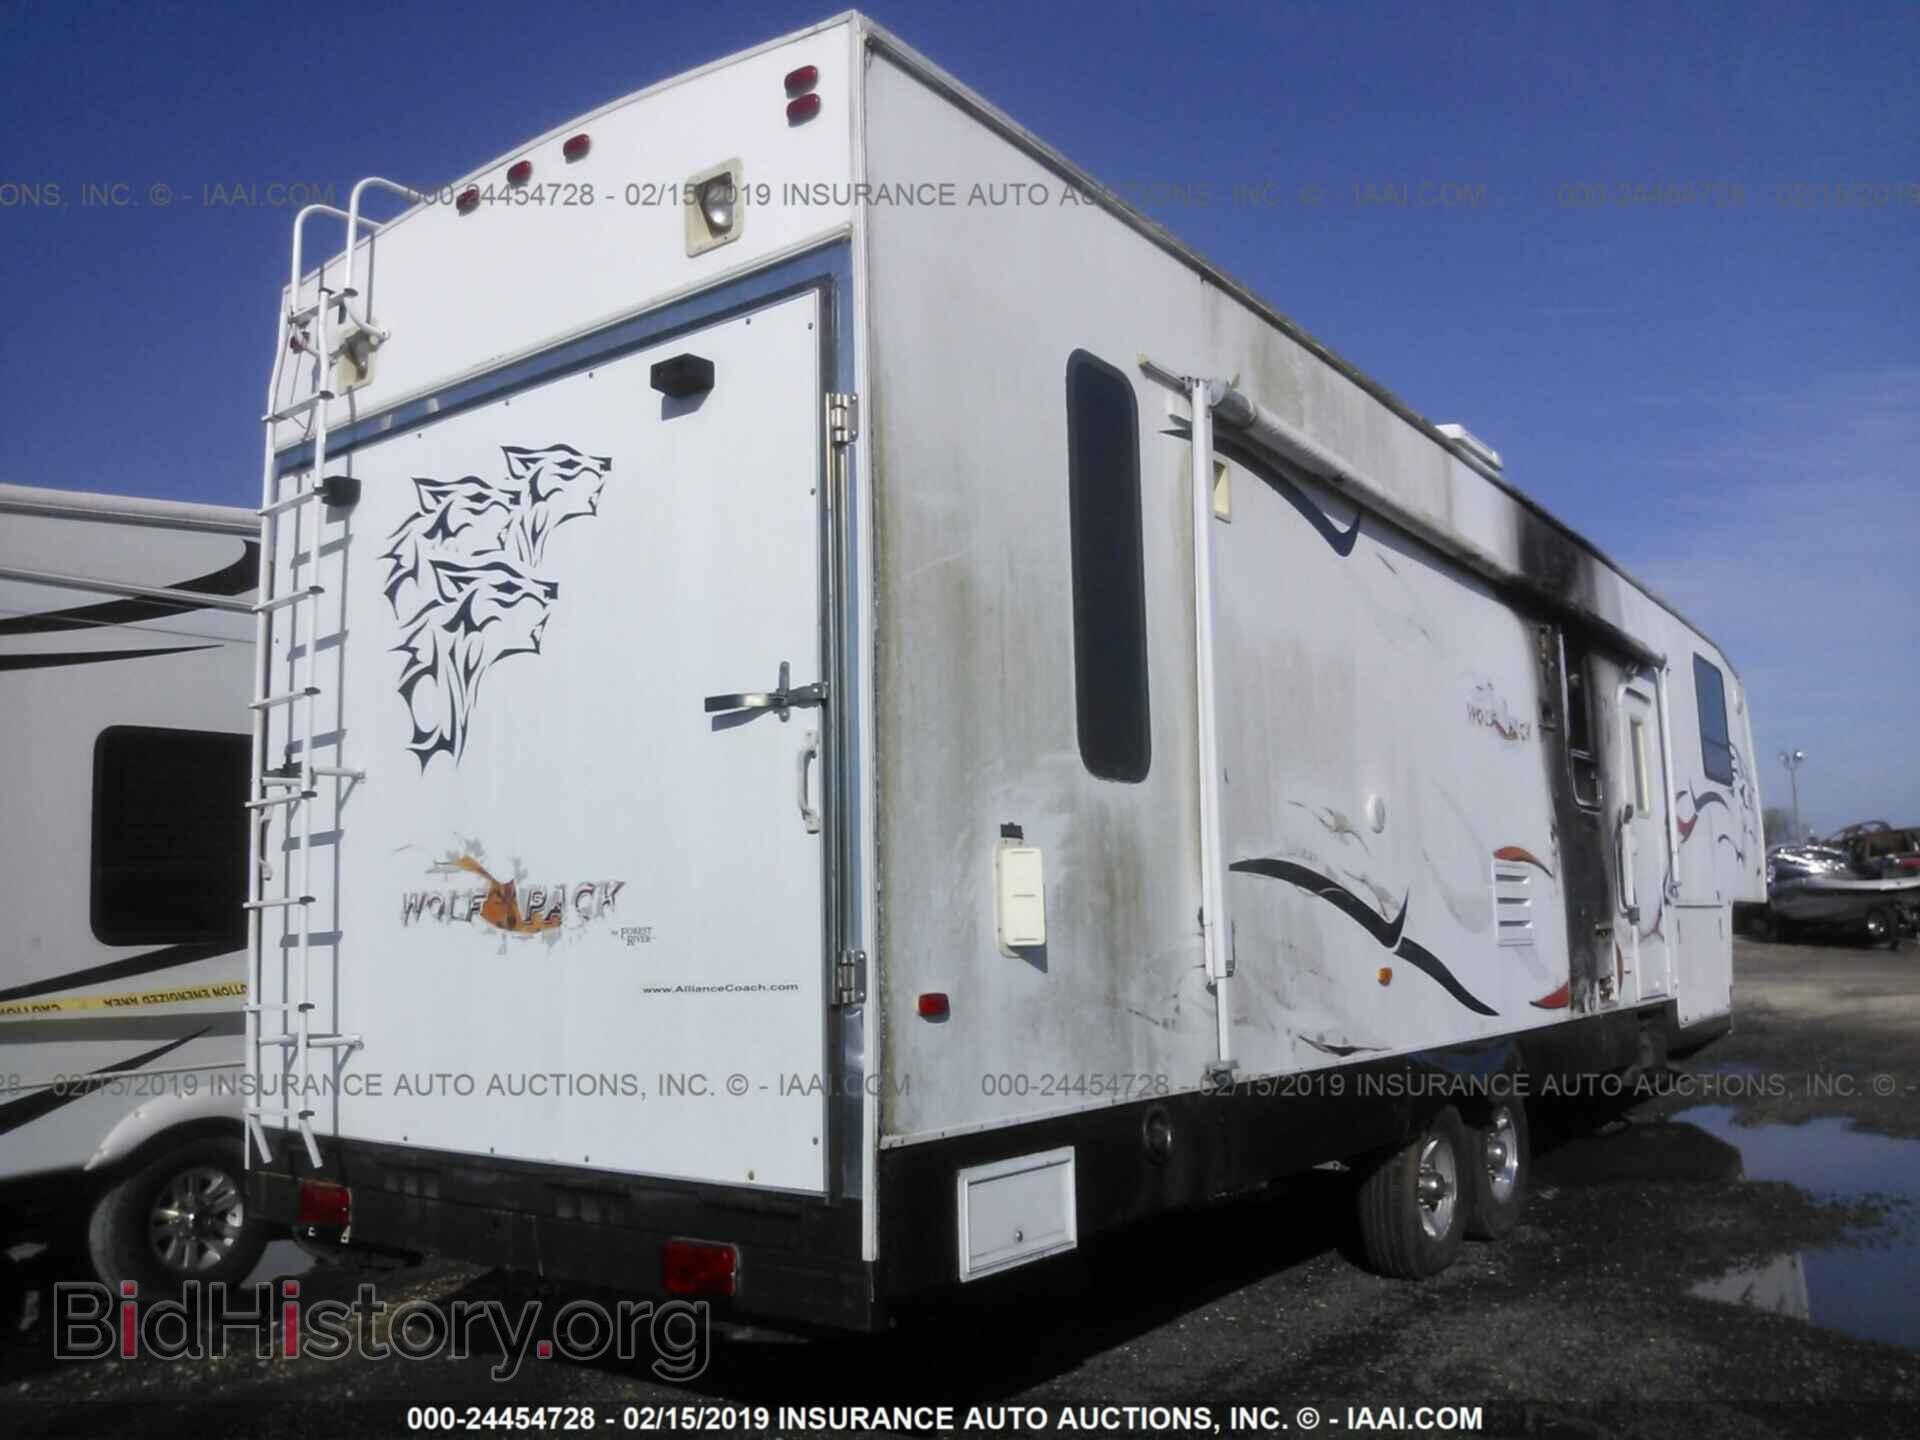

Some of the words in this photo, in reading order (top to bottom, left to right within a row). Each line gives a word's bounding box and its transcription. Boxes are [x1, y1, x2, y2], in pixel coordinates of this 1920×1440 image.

[402, 888, 490, 928] WOLF
[520, 879, 627, 926] PACK
[643, 983, 799, 994] www.AllianceCoach.com
